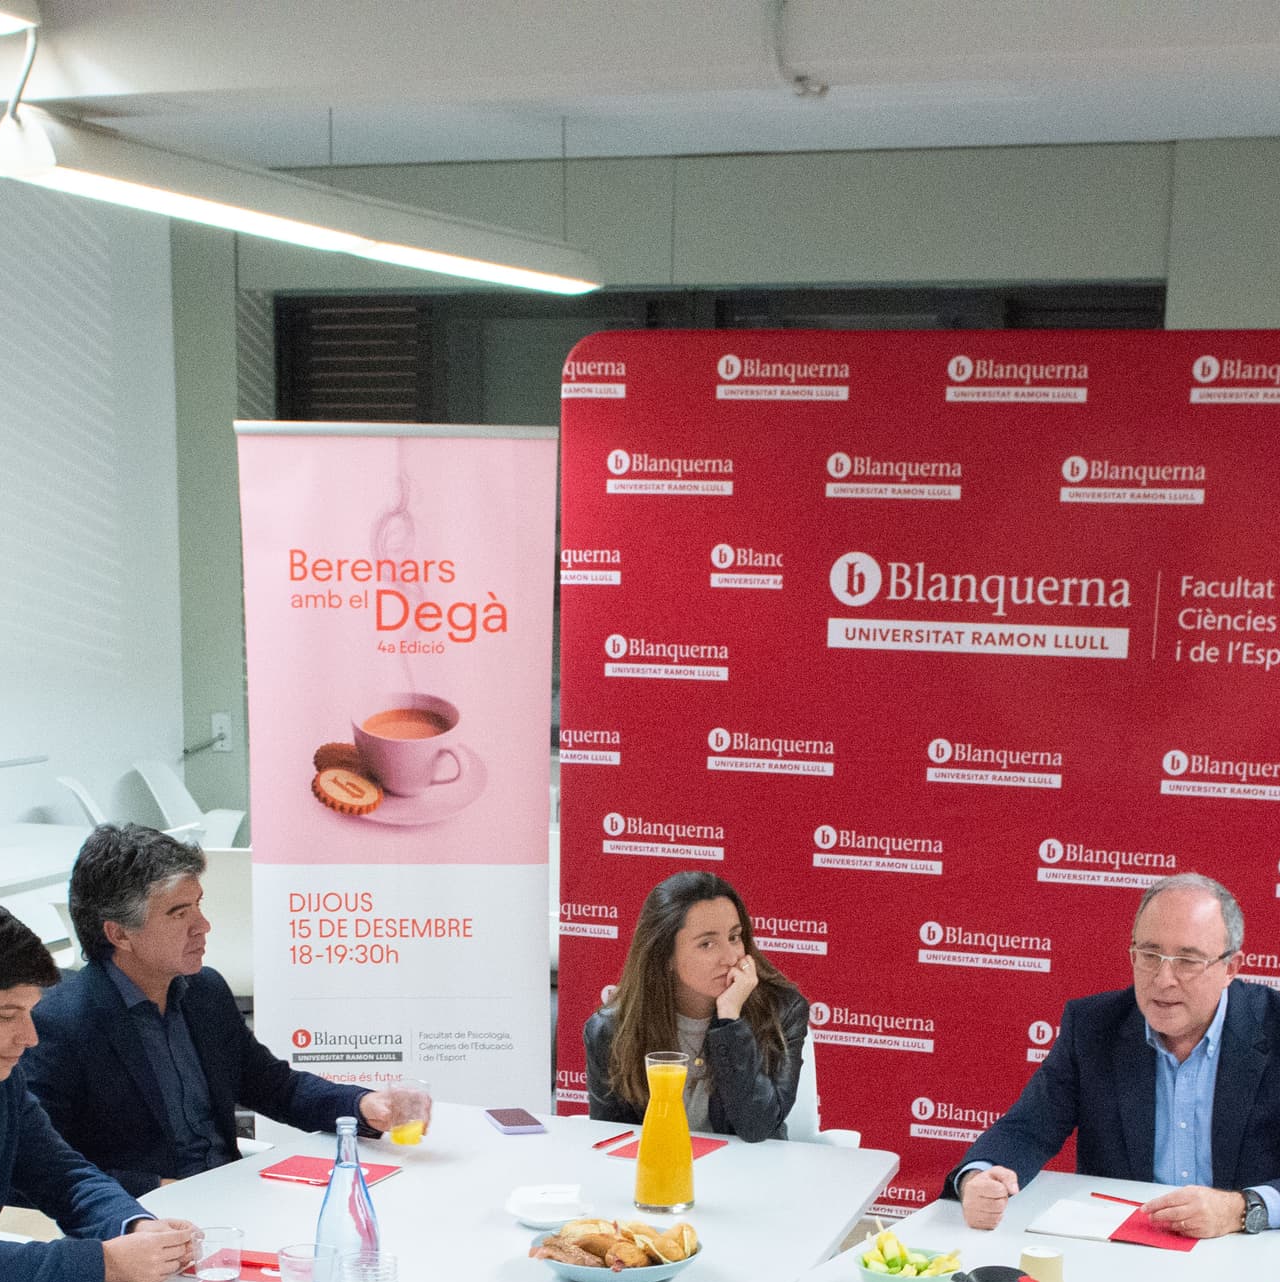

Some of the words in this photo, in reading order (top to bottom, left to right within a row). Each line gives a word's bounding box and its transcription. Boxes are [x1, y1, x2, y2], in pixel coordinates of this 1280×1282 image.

[744, 359, 848, 382] Blanquerna
[976, 361, 1087, 384] Blanquerna
[631, 454, 733, 477] Blanquerna
[854, 457, 961, 481] Blanquerna
[1089, 461, 1205, 485] Blanquerna
[289, 549, 456, 583] Berenars
[718, 577, 770, 585] UNIVERSITAT
[886, 562, 1131, 616] Blanquerna
[1180, 575, 1275, 599] Facultat
[291, 590, 342, 608] amb
[349, 590, 368, 608] el
[376, 589, 508, 643] Degà
[1177, 608, 1277, 632] Ciències
[377, 640, 395, 654] 4a
[399, 640, 445, 654] Edició
[845, 627, 965, 645] UNIVERSITAT
[971, 631, 1046, 648] RAMON
[1054, 634, 1109, 650] LLULL
[629, 639, 728, 662] Blanquerna
[1175, 640, 1182, 662] i
[1190, 640, 1220, 663] de
[612, 667, 661, 675] UNIVERSITAT
[733, 733, 834, 757] Blanquerna
[955, 744, 1062, 769] Blanquerna
[714, 760, 765, 769] UNIVERSITAT
[767, 763, 800, 771] RAMON
[802, 765, 826, 773] LLULL
[934, 772, 989, 781] UNIVERSITAT
[991, 775, 1025, 783] RAMON
[1028, 777, 1054, 785] LLULL
[1169, 784, 1227, 794] UNIVERSITAT
[1229, 788, 1265, 796] RAMON
[627, 817, 724, 841] Blanquerna
[610, 844, 659, 853] UNIVERSITAT
[660, 847, 691, 855] RAMON
[694, 849, 717, 857] LLULL
[840, 830, 942, 855] Blanquerna
[820, 857, 872, 867] UNIVERSITAT
[874, 861, 907, 869] RAMON
[910, 863, 934, 871] LLULL
[1065, 844, 1176, 869] Blanquerna
[1045, 872, 1101, 881] UNIVERSITAT
[1104, 876, 1138, 884] RAMON
[289, 892, 373, 912] DIJOUS
[289, 919, 312, 939] 15
[319, 918, 348, 938] DE
[355, 918, 473, 938] DESEMBRE
[946, 927, 1051, 952] Blanquerna
[289, 944, 399, 964] 18-19:30h
[925, 954, 979, 964] UNIVERSITAT
[981, 958, 1015, 967] RAMON
[1018, 961, 1043, 969] LLULL
[832, 1007, 934, 1032] Blanquerna
[314, 1031, 403, 1049] Blanquerna
[419, 1031, 452, 1039] Facultat
[454, 1031, 466, 1039] de
[458, 1042, 469, 1050] de
[814, 1033, 865, 1043] UNIVERSITAT
[868, 1038, 900, 1046] RAMON
[902, 1041, 926, 1049] LLULL
[917, 1128, 970, 1138] UNIVERSITAT
